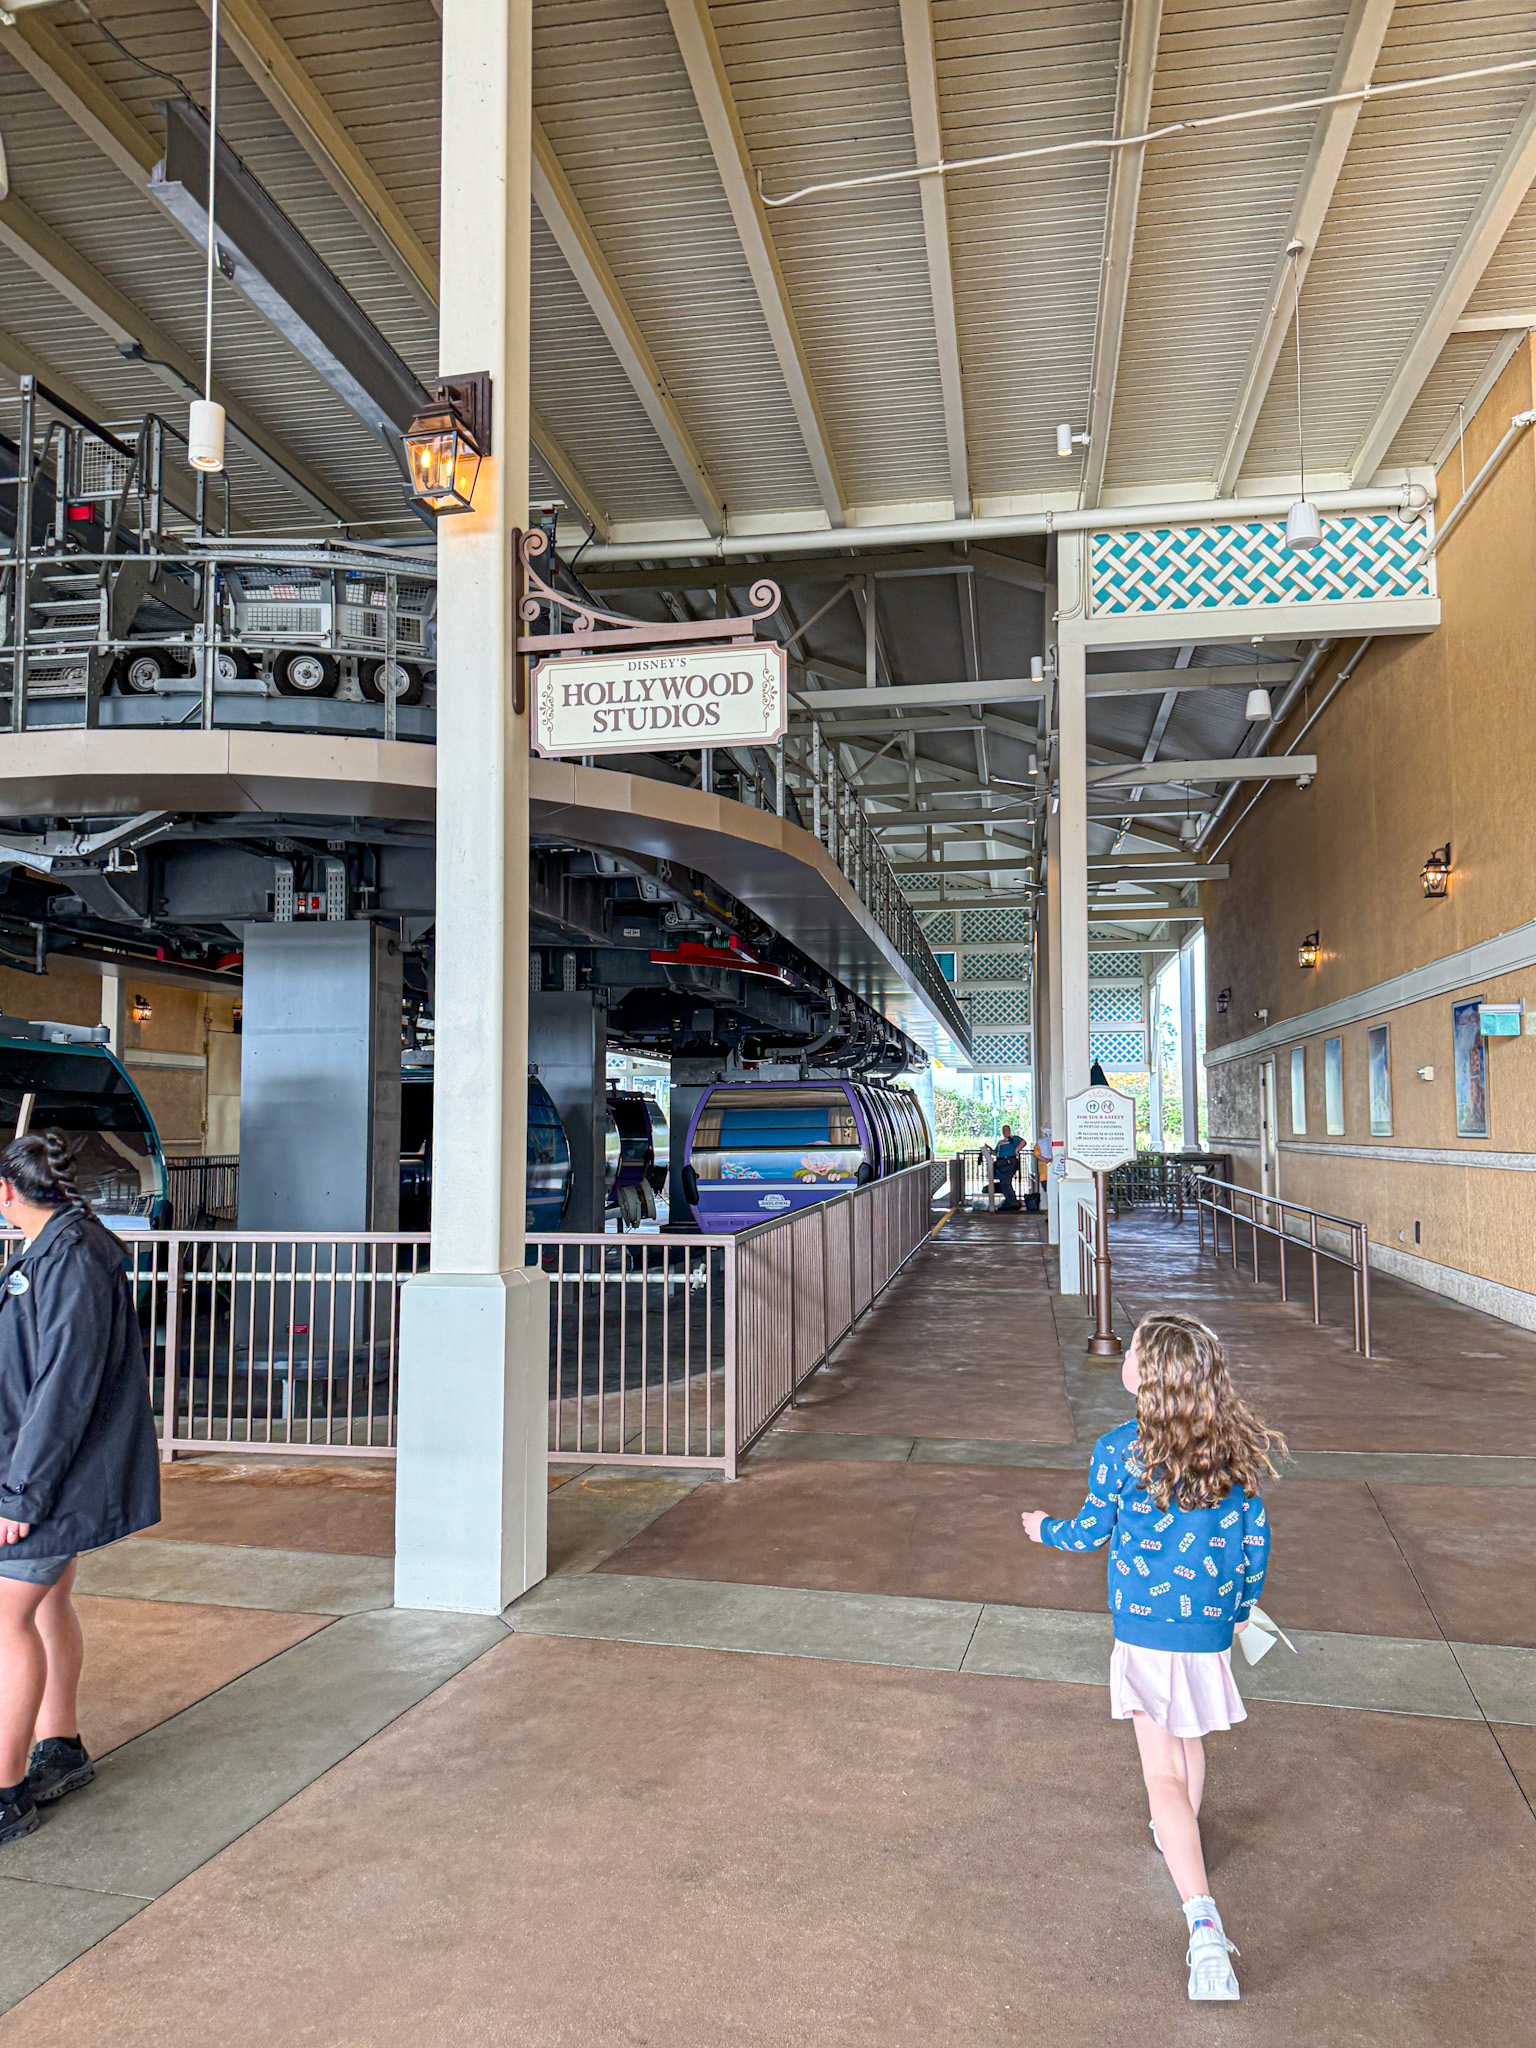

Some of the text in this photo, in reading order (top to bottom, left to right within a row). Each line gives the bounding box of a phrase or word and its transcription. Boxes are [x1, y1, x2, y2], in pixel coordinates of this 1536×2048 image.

[628, 657, 687, 671] DISNEY'S
[561, 671, 754, 707] HOLLYWOOD
[592, 702, 721, 733] STUDIOS
[1140, 1543, 1162, 1551] WARS
